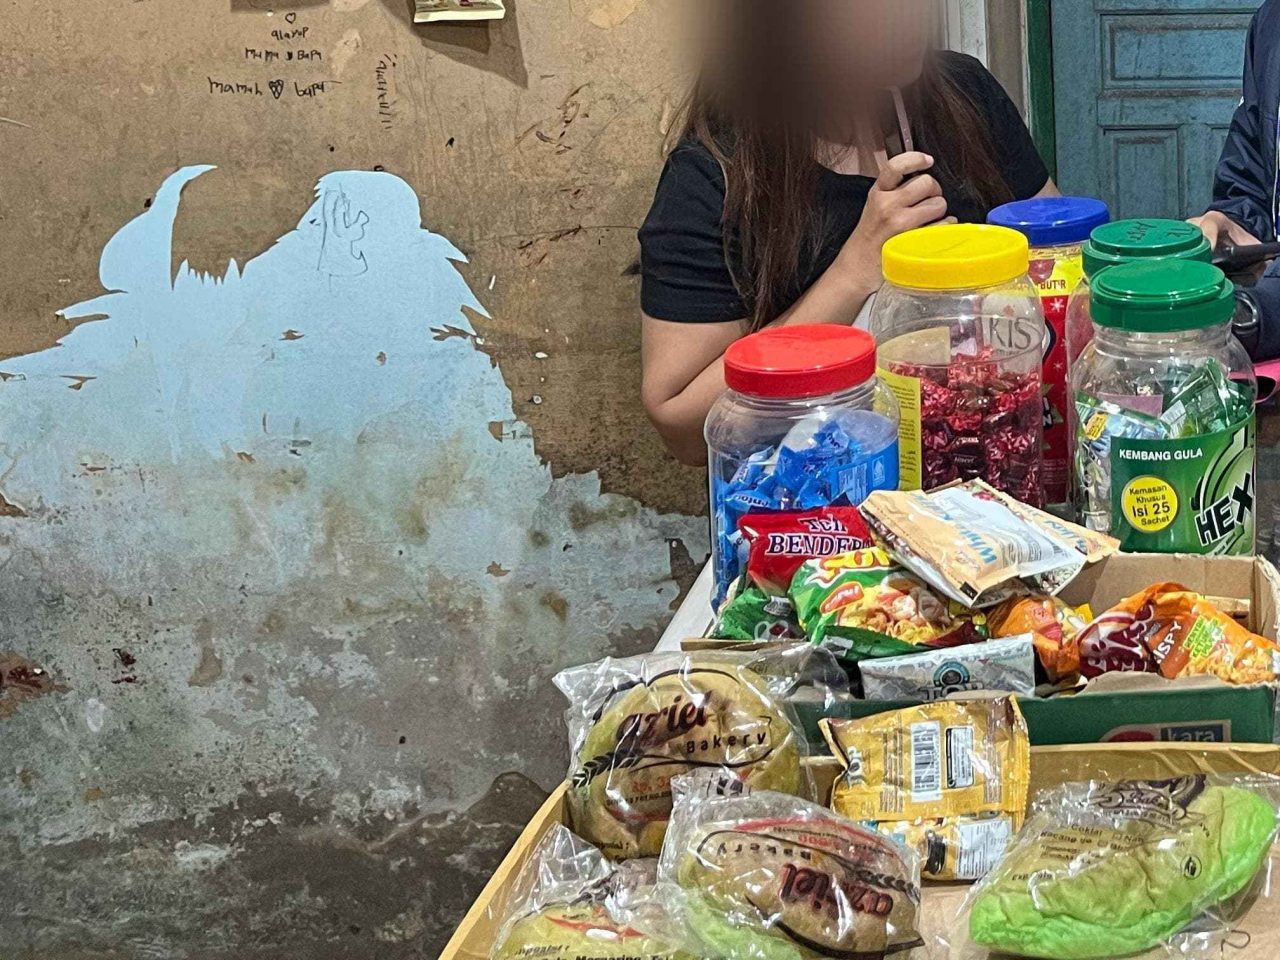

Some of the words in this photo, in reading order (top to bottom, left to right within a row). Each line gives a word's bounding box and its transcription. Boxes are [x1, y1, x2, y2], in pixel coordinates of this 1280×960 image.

[989, 317, 1032, 350] KIS
[1119, 448, 1171, 461] KEMBANG
[1174, 447, 1203, 460] GULA
[1129, 484, 1167, 495] Kemasan
[1136, 495, 1166, 503] Khusus
[1132, 505, 1148, 517] Isi
[1152, 502, 1170, 515] 25
[1141, 515, 1169, 526] Sachet
[686, 732, 766, 753] Bakery
